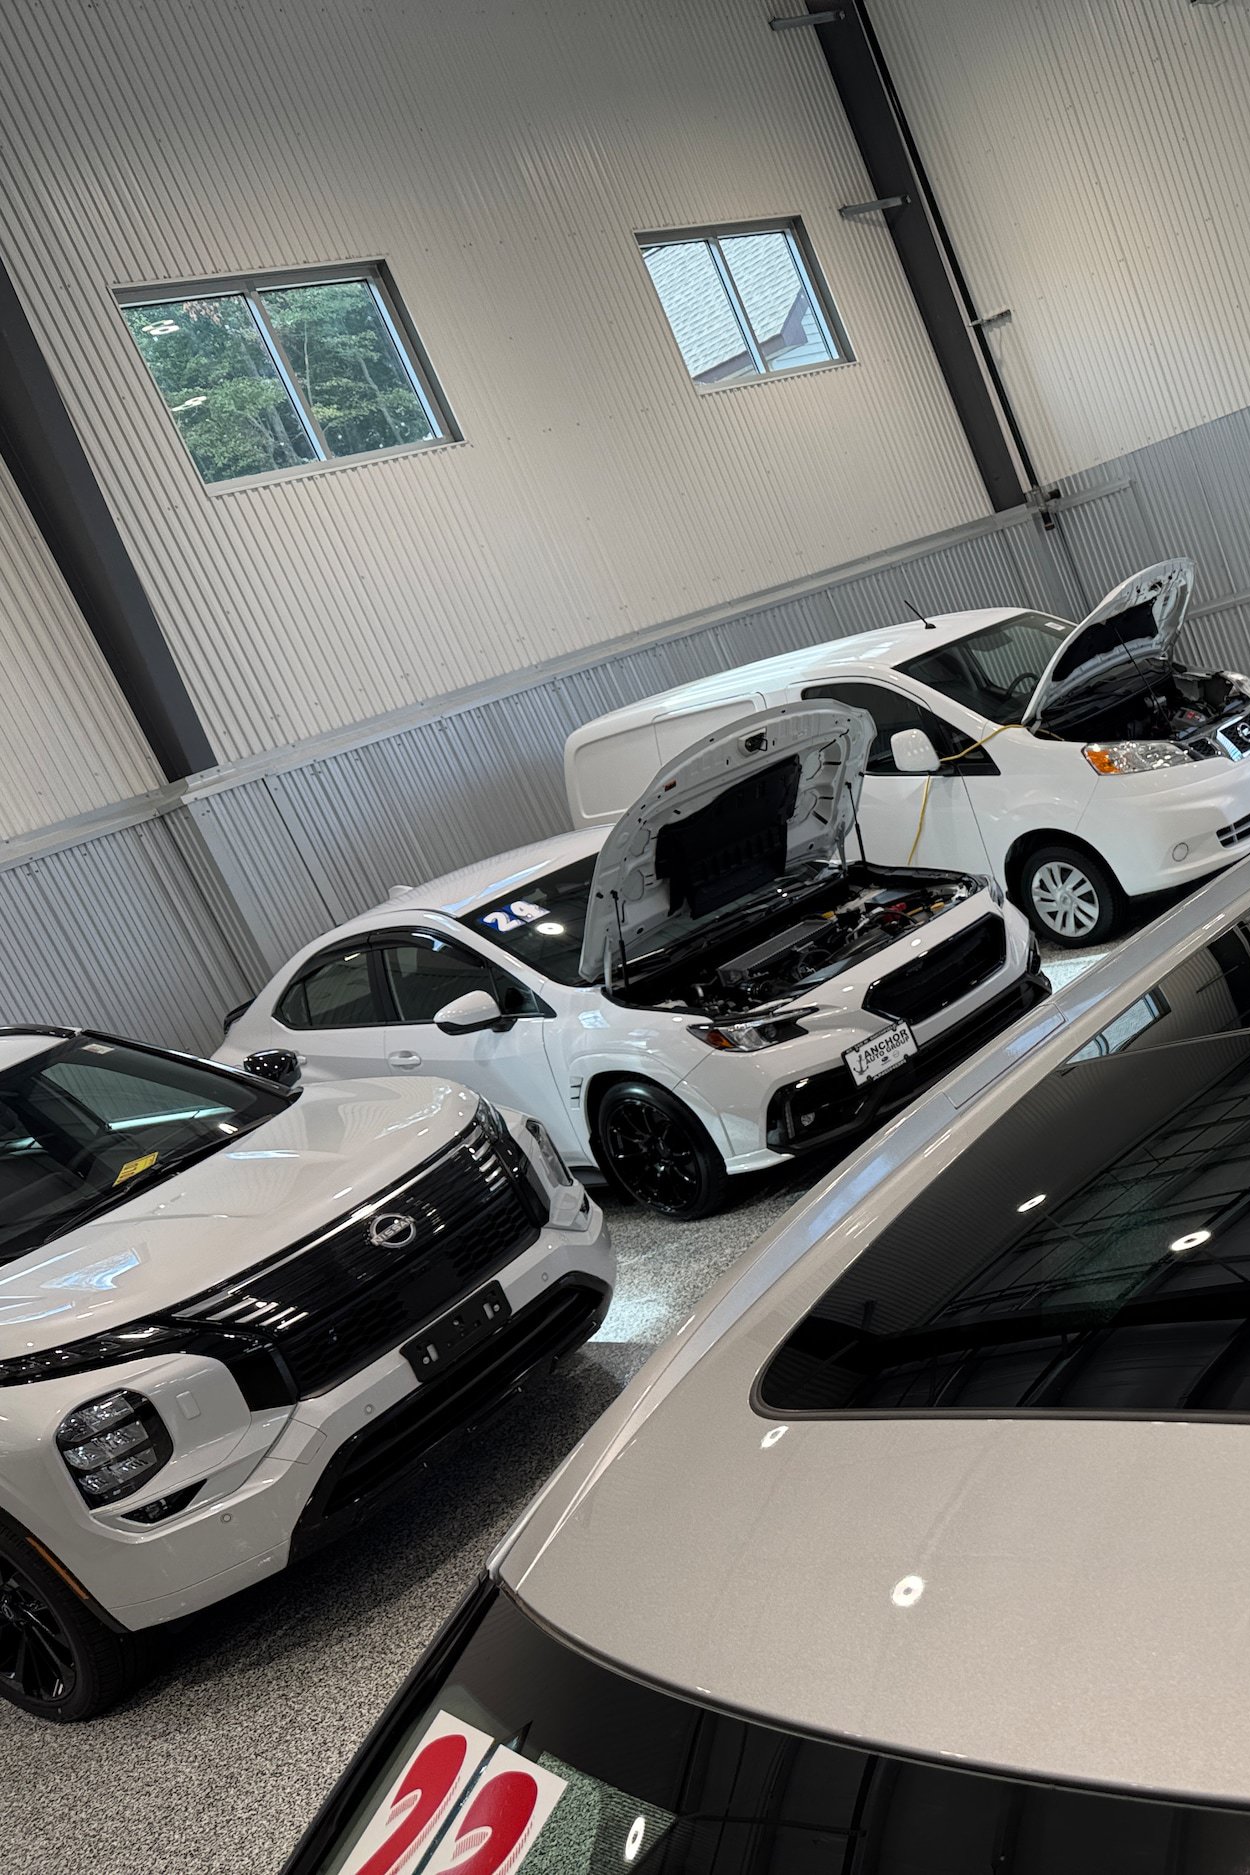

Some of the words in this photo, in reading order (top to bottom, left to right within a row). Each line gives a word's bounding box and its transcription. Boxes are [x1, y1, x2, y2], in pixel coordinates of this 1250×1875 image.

[483, 901, 550, 931] 24
[864, 1029, 909, 1058] ANCHOR
[865, 1050, 885, 1065] AUTO
[886, 1035, 910, 1053] GROUP
[371, 1216, 415, 1246] NISSAN
[355, 1733, 538, 1875] 22
